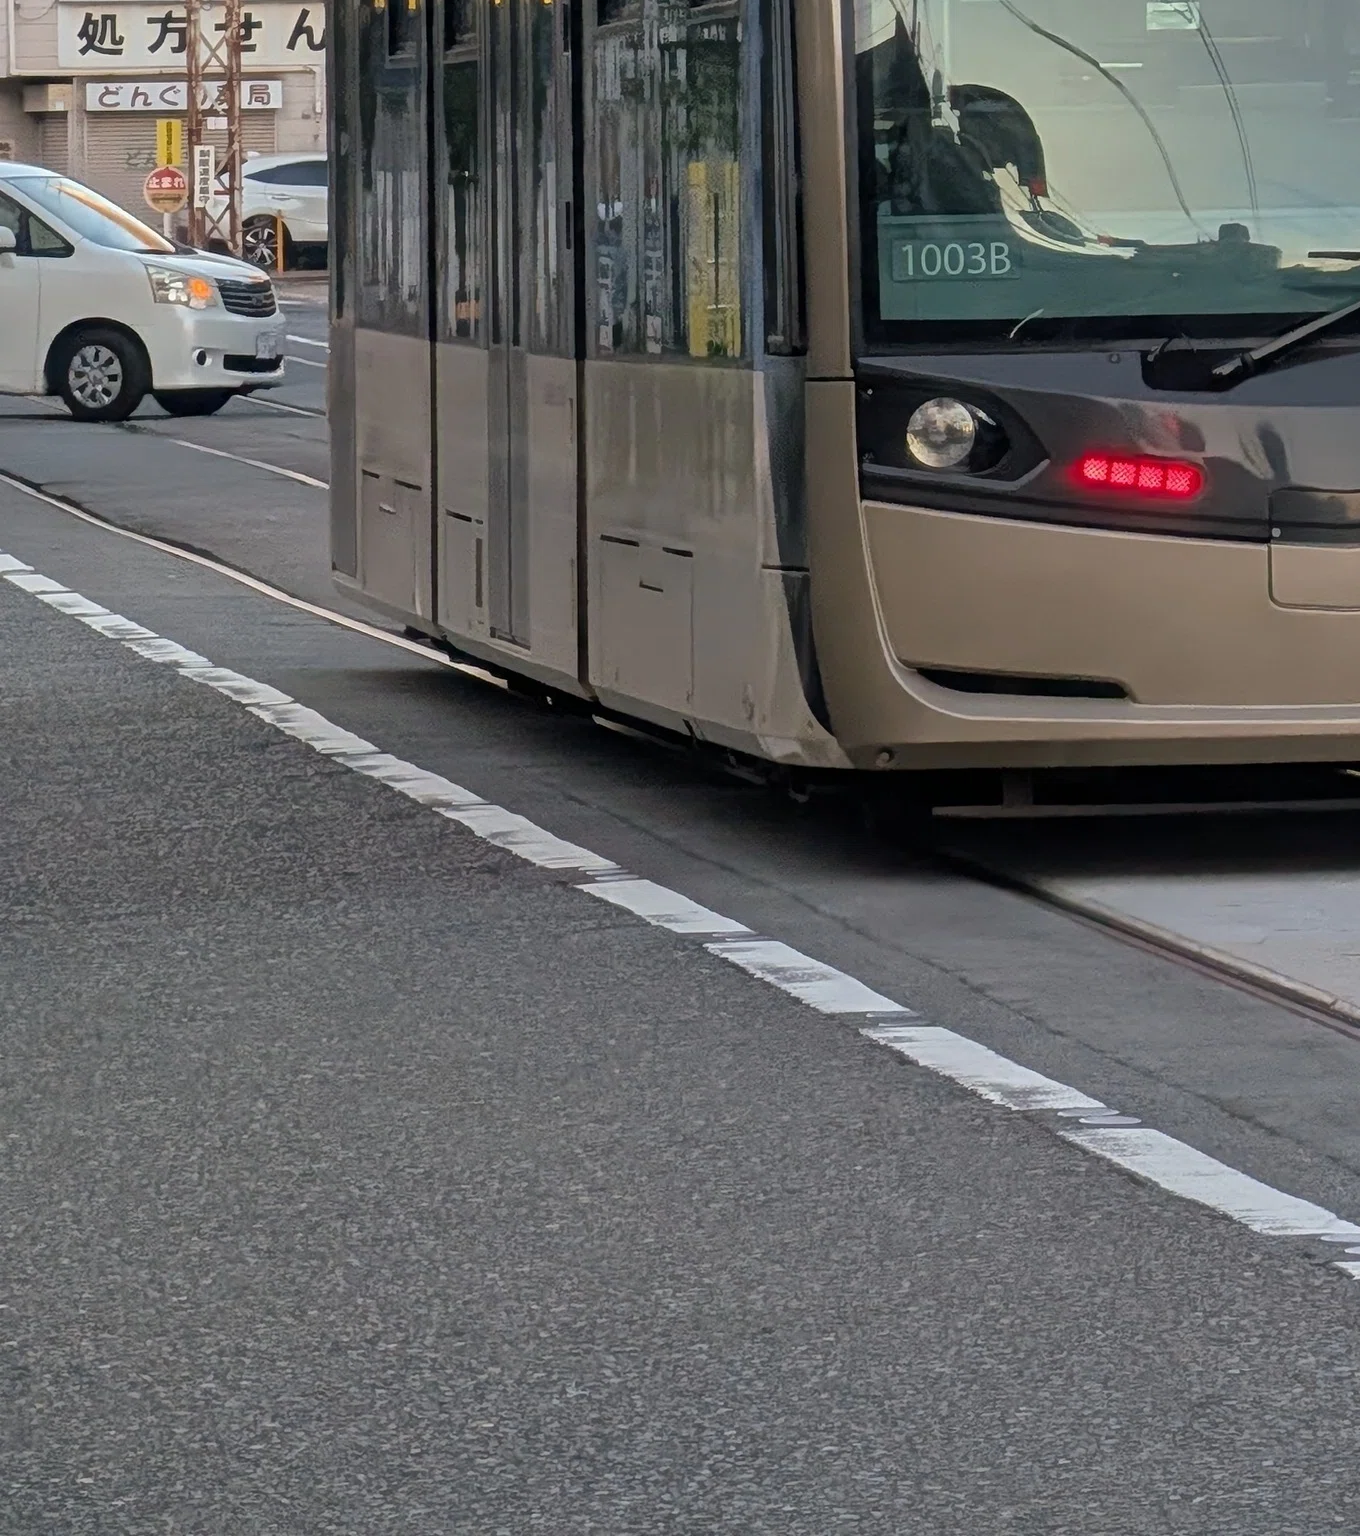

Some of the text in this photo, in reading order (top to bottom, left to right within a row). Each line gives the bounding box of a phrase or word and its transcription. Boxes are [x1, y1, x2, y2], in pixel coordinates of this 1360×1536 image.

[77, 7, 326, 57] 処方せん
[902, 241, 1012, 276] 1003B
